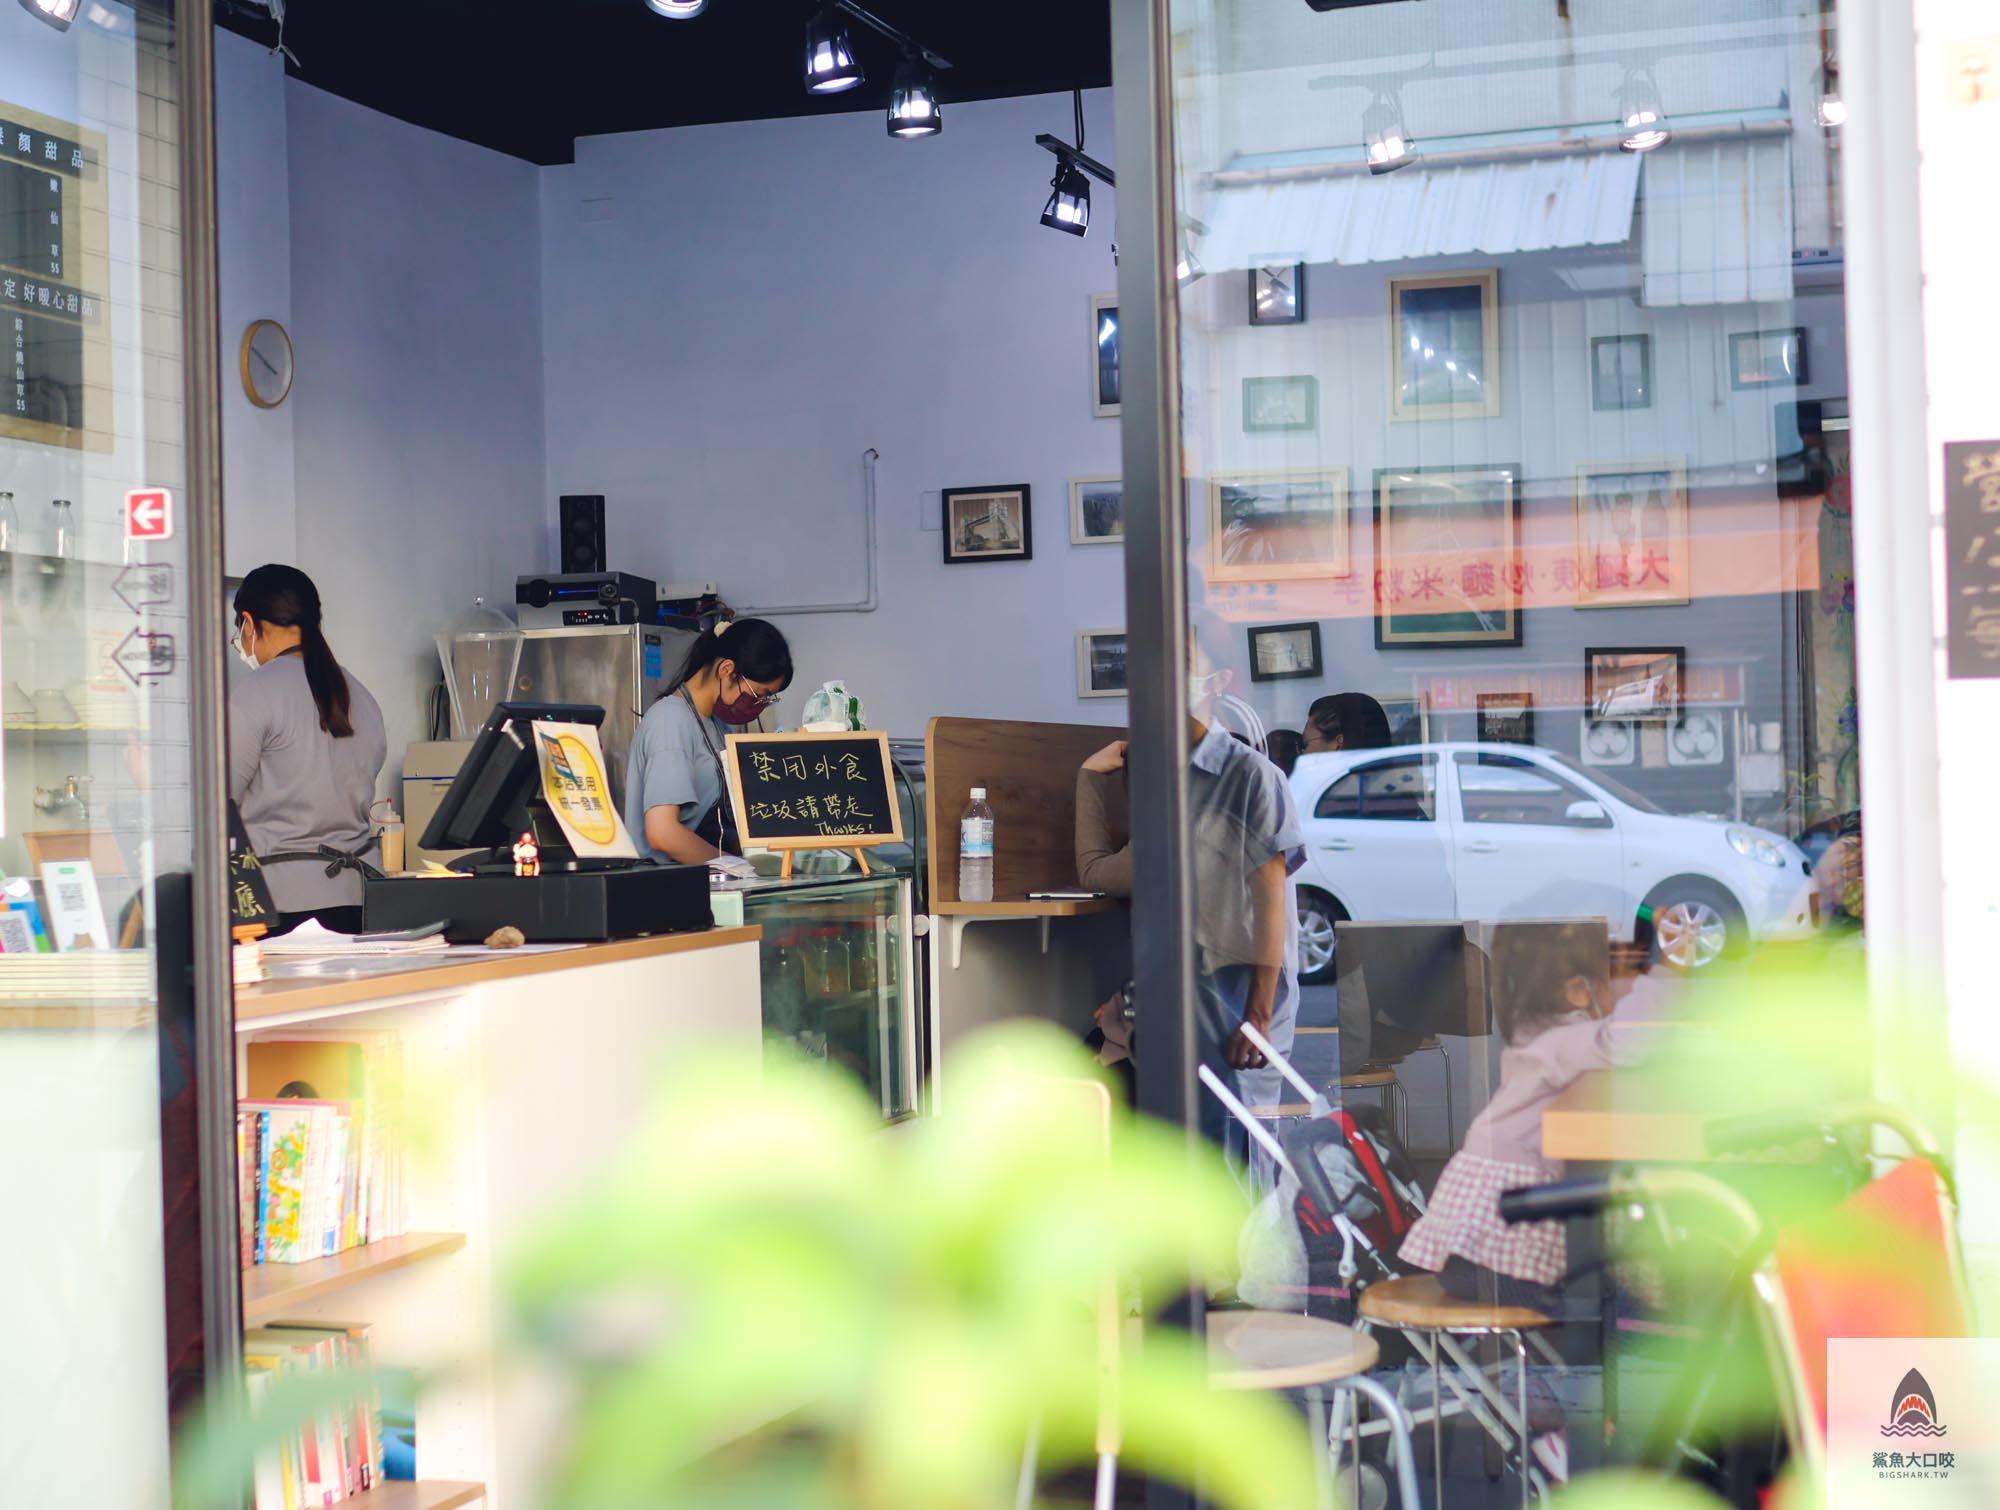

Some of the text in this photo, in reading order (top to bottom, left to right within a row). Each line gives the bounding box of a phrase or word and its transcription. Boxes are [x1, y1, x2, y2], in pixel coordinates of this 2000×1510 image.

[0, 277, 93, 317] 定好暖心甜品
[749, 793, 874, 820] 垃圾請帶走
